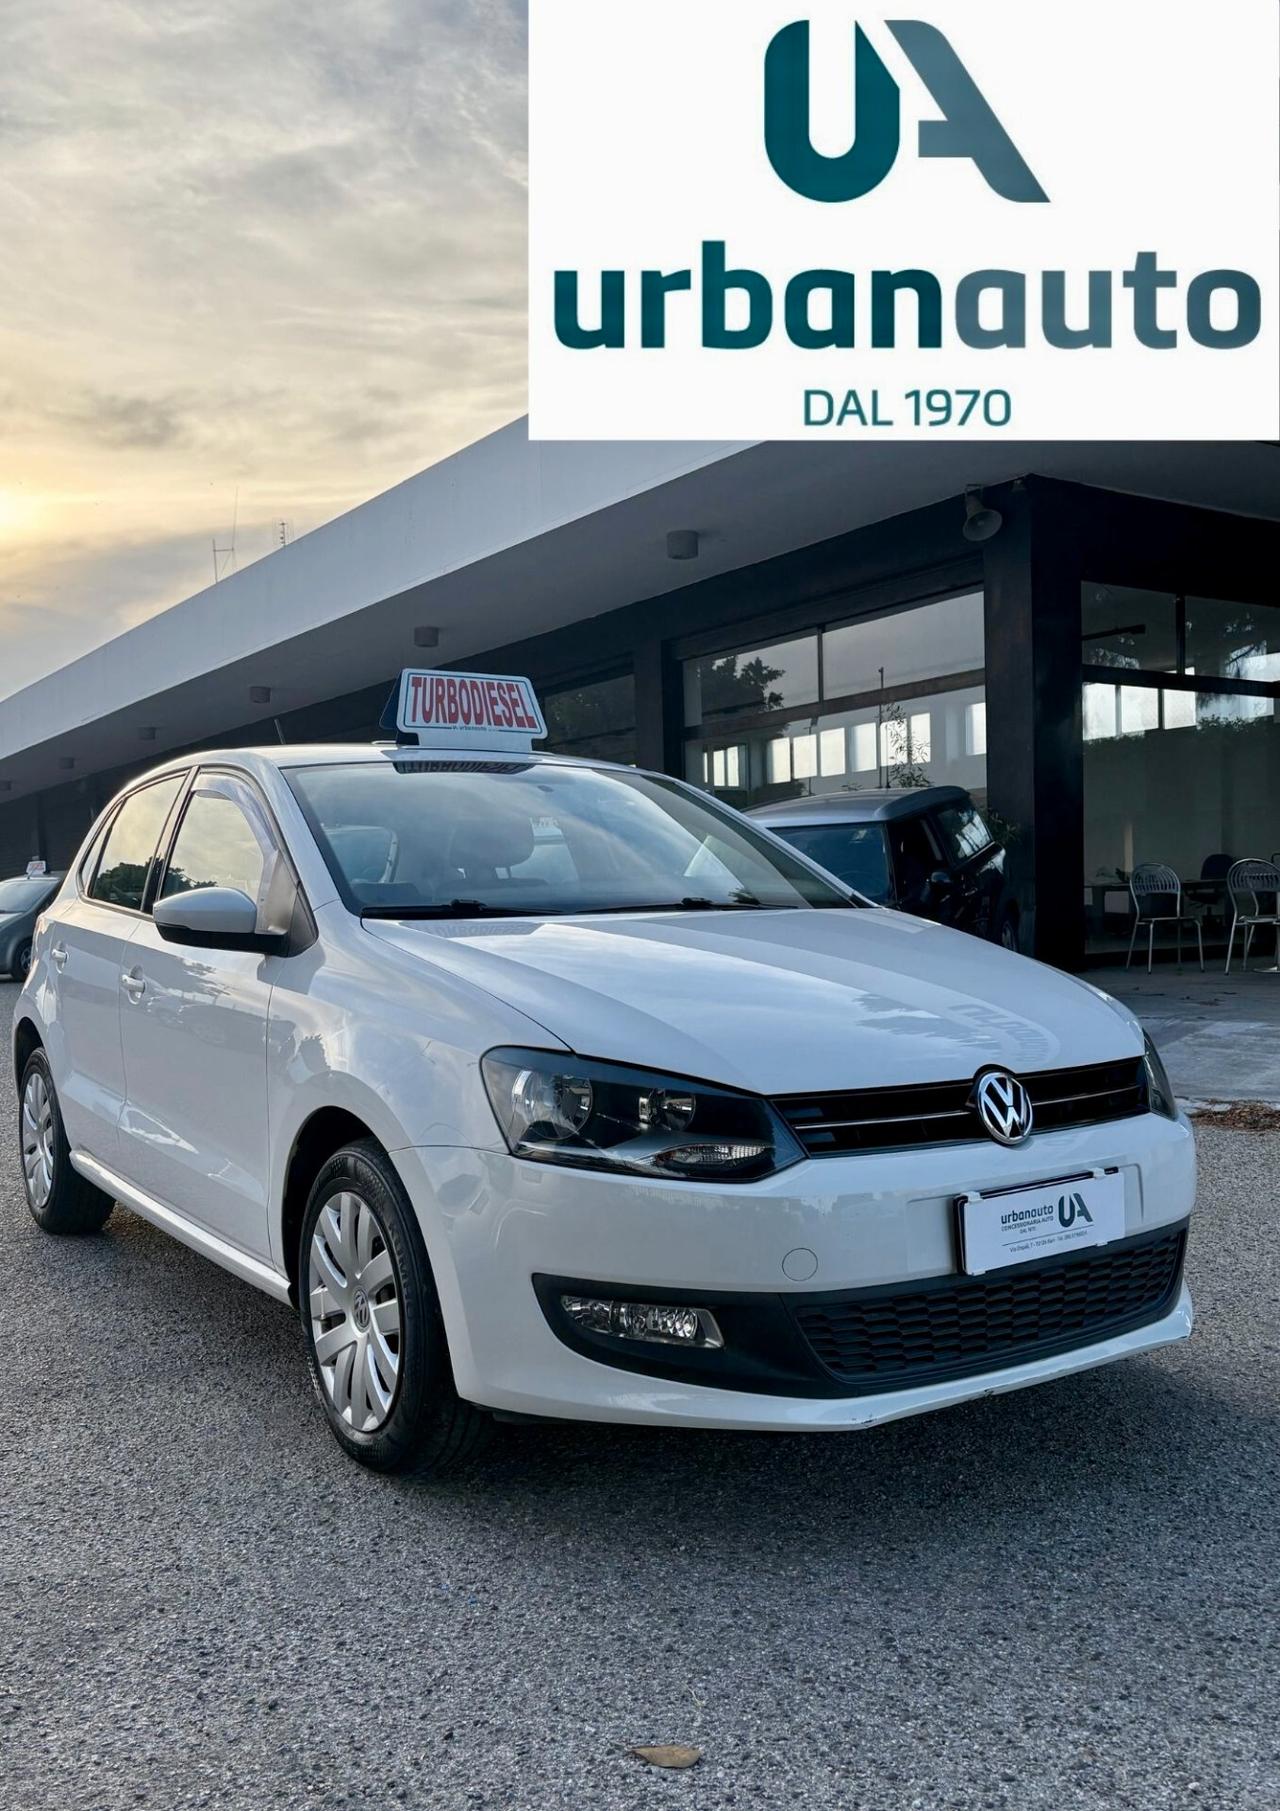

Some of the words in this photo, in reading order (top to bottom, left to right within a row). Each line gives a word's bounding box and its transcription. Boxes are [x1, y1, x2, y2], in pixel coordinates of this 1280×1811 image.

[411, 676, 538, 729] TURBODIESEL
[1001, 1205, 1054, 1224] urbanauto
[1058, 1193, 1093, 1228] UA
